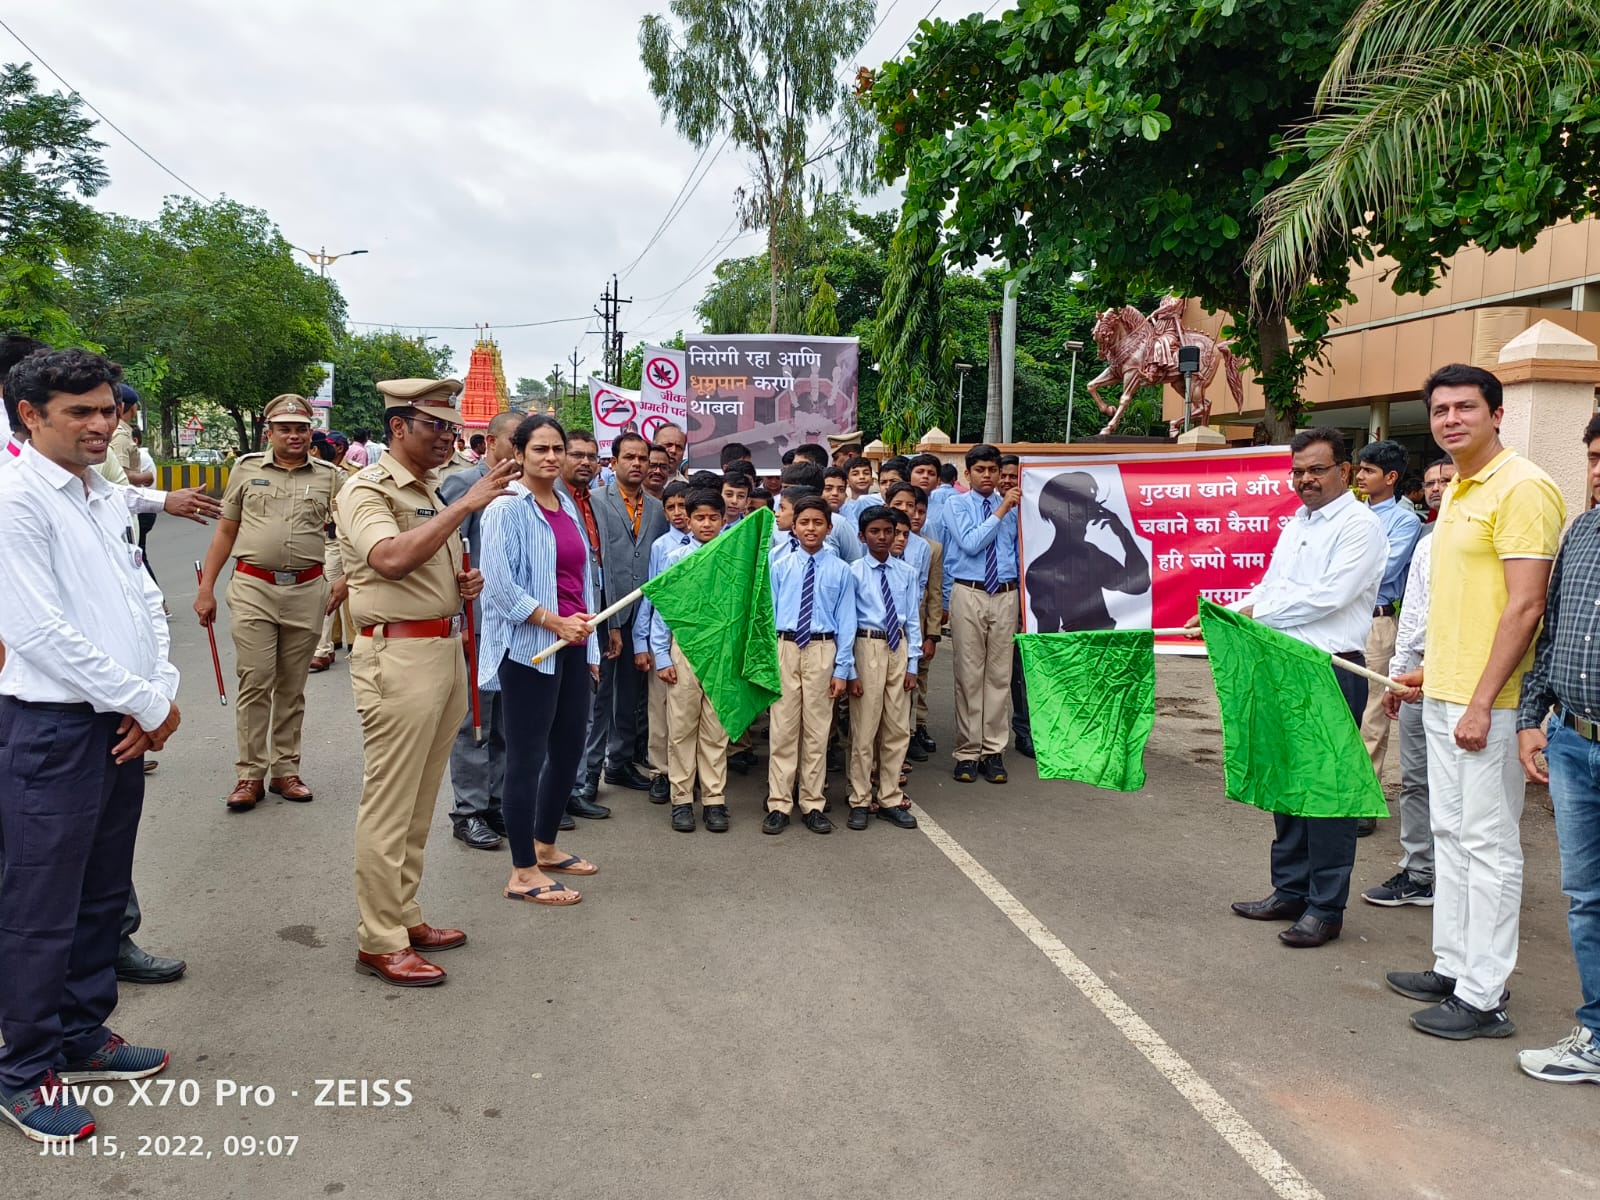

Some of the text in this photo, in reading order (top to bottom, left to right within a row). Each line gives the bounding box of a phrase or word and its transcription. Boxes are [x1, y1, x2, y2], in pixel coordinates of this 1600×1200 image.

[688, 345, 822, 369] निरोगी रहा आणि
[690, 371, 795, 396] धूम्रपान करणे
[690, 395, 744, 416] थांबवा
[1139, 484, 1191, 506] गुटखा
[1197, 476, 1238, 497] खाने
[1245, 474, 1280, 496] और
[1138, 512, 1188, 535] चबाने
[1194, 517, 1221, 533] का
[1226, 510, 1270, 533] कैसा
[1157, 546, 1265, 571] हरि जपो नाम
